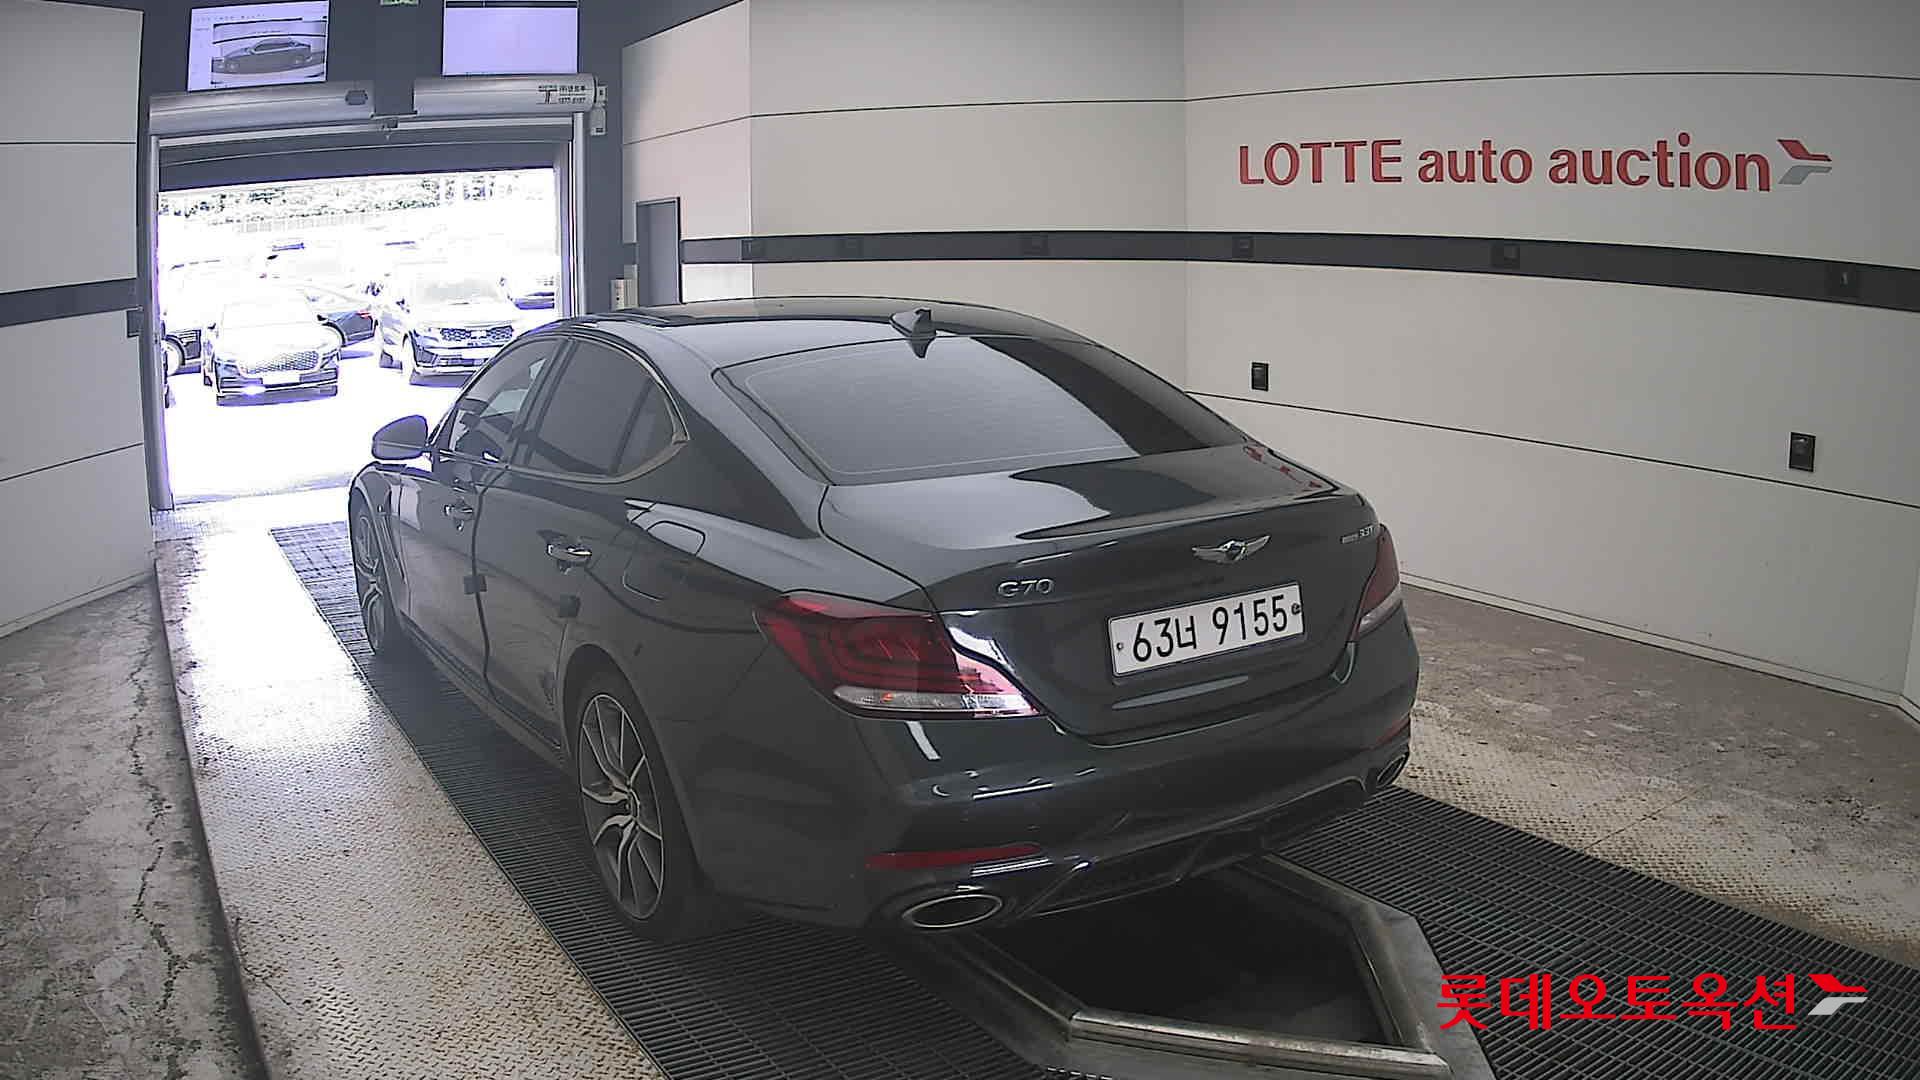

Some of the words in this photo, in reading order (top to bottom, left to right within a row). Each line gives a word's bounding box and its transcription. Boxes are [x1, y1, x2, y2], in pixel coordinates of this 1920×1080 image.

[1239, 138, 1402, 186] LOTTE
[1417, 139, 1533, 185] auto
[1548, 132, 1772, 192] auction
[998, 578, 1054, 597] G70
[1132, 615, 1197, 662] 63너
[1212, 594, 1288, 645] 9155
